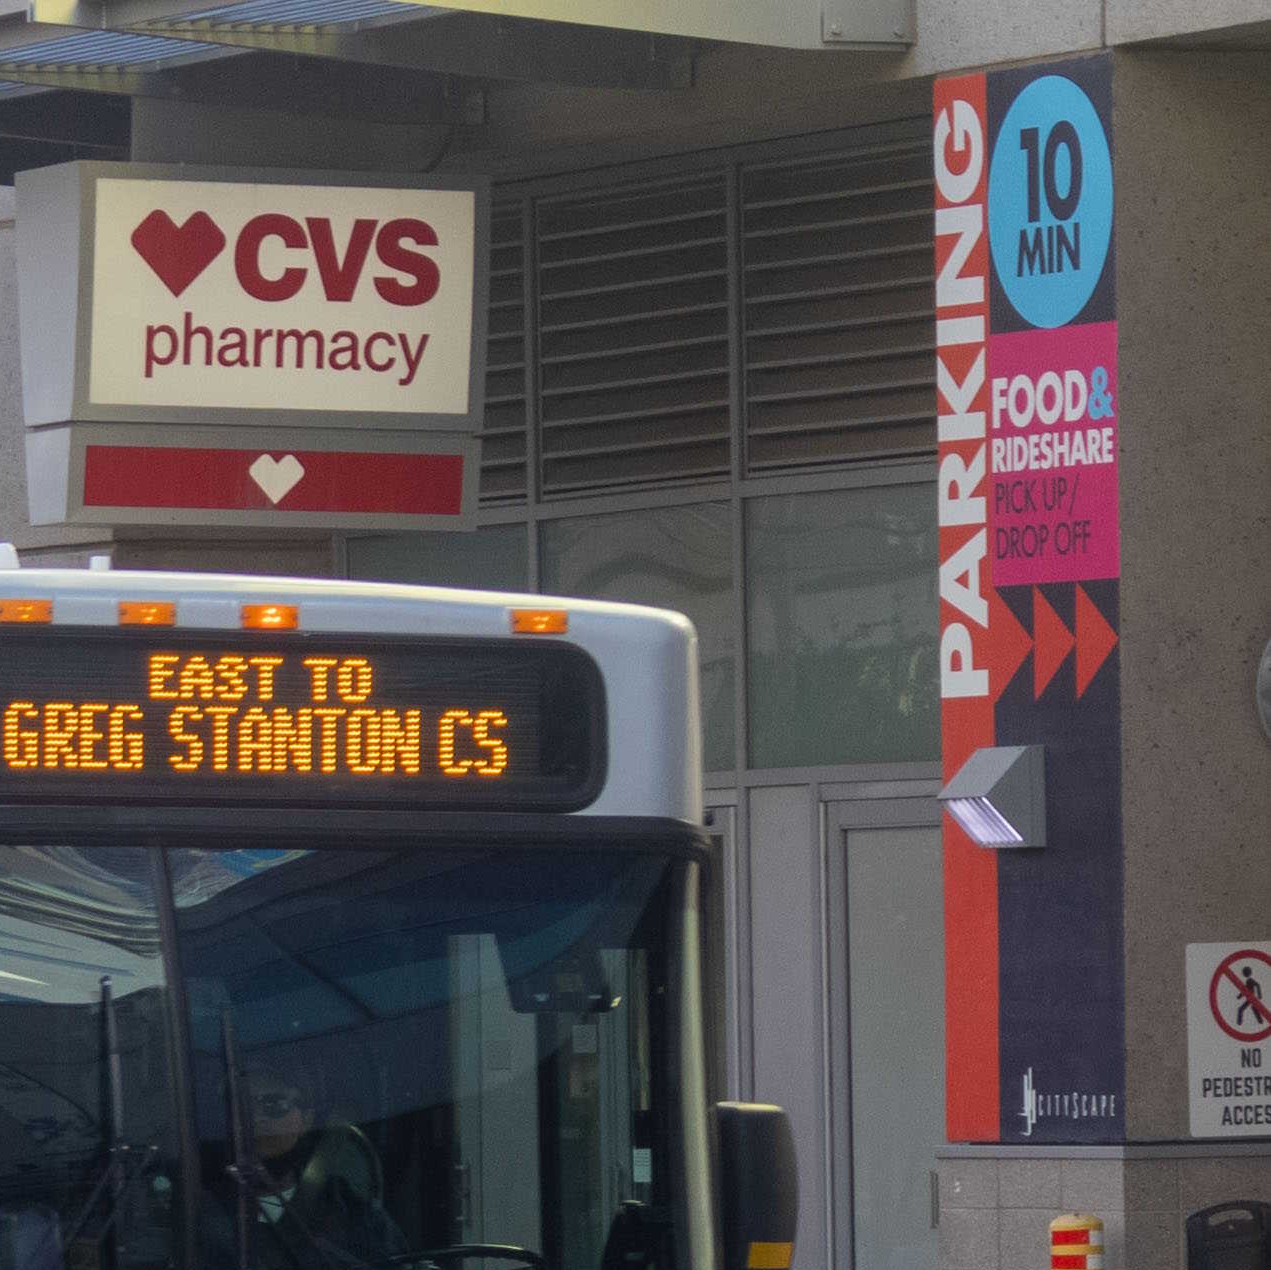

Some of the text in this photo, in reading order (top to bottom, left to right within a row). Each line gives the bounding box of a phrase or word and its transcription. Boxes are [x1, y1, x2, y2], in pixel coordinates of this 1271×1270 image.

[1019, 119, 1084, 223] 10
[234, 213, 441, 307] CVS
[1017, 222, 1081, 277] MIN
[144, 311, 431, 386] pharmacy
[933, 99, 990, 699] PARKING
[992, 427, 1115, 474] RIDESHARE
[995, 479, 1038, 515] PICK
[995, 520, 1091, 560] DROP OFF
[148, 654, 373, 702] EAST TO
[4, 702, 508, 775] GREG STANTON CS
[1241, 1048, 1262, 1069] NO
